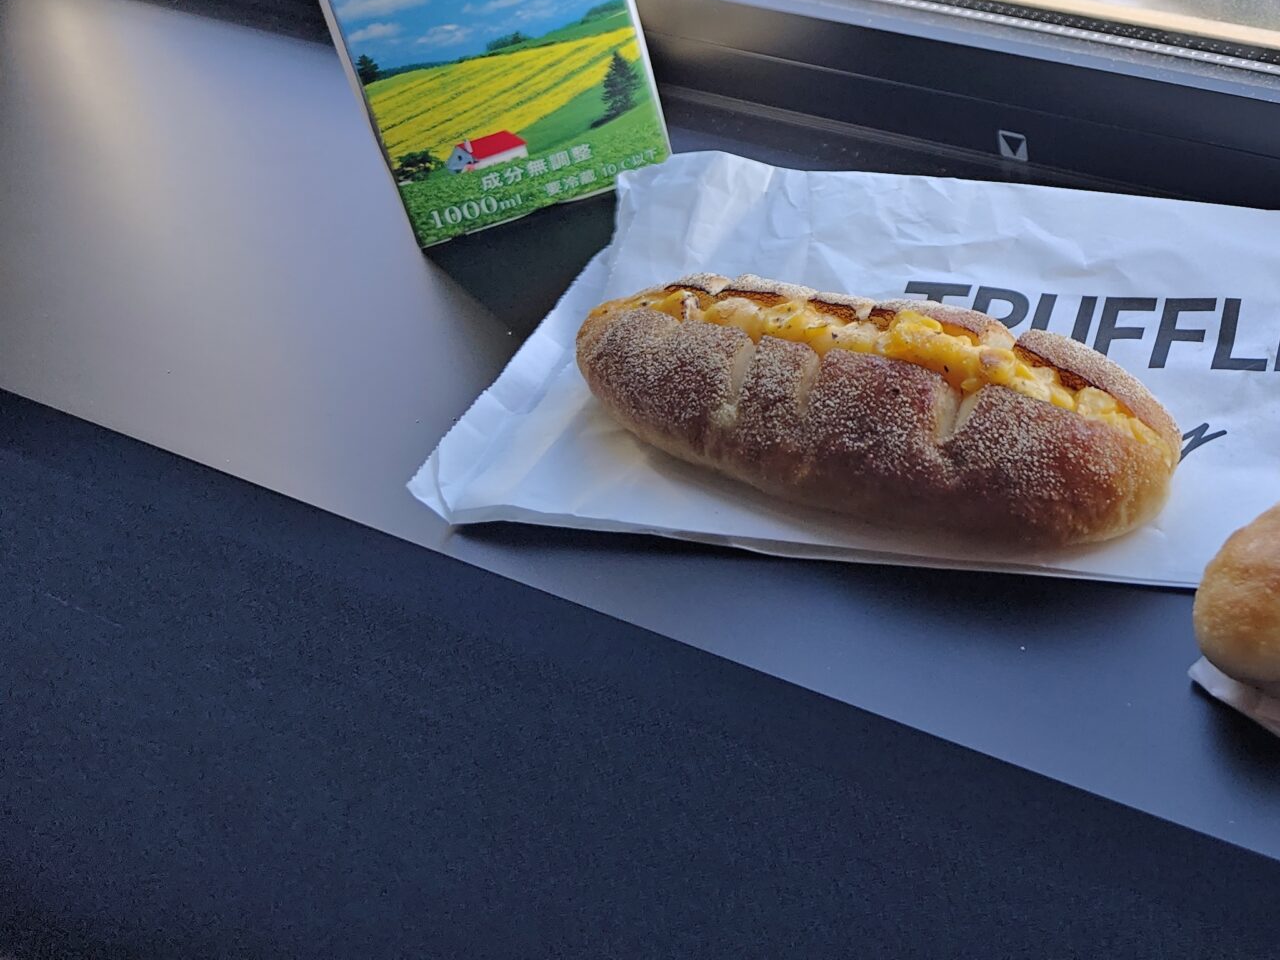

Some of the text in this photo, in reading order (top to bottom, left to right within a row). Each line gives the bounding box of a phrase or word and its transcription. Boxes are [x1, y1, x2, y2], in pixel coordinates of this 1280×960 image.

[480, 143, 594, 192] 成分無調整
[429, 194, 523, 230] 1000ml
